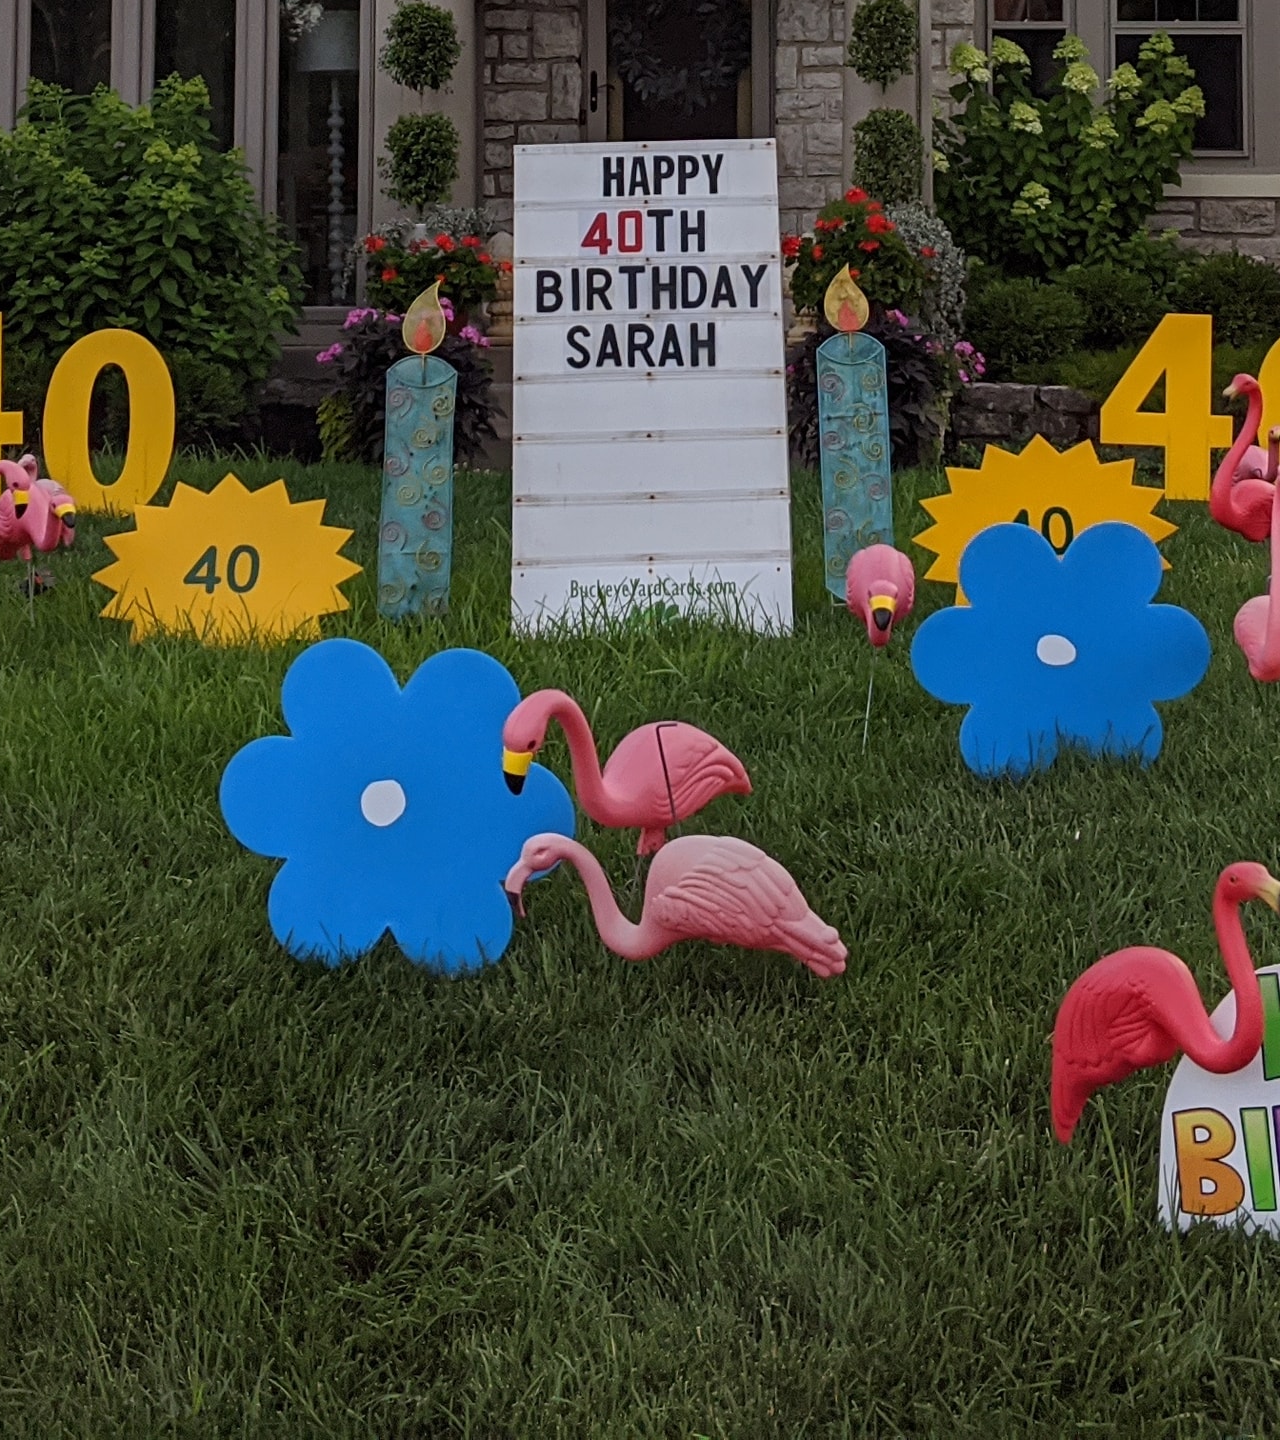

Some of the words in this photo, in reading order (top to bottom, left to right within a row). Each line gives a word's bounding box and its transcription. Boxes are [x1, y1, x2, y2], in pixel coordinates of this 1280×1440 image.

[602, 153, 724, 197] HAPPY
[581, 209, 706, 255] 40TH
[536, 264, 768, 313] BIRTHDAY
[566, 322, 716, 369] SARAH
[183, 544, 260, 594] 40
[570, 577, 737, 600] BuckeyeYardCards.com
